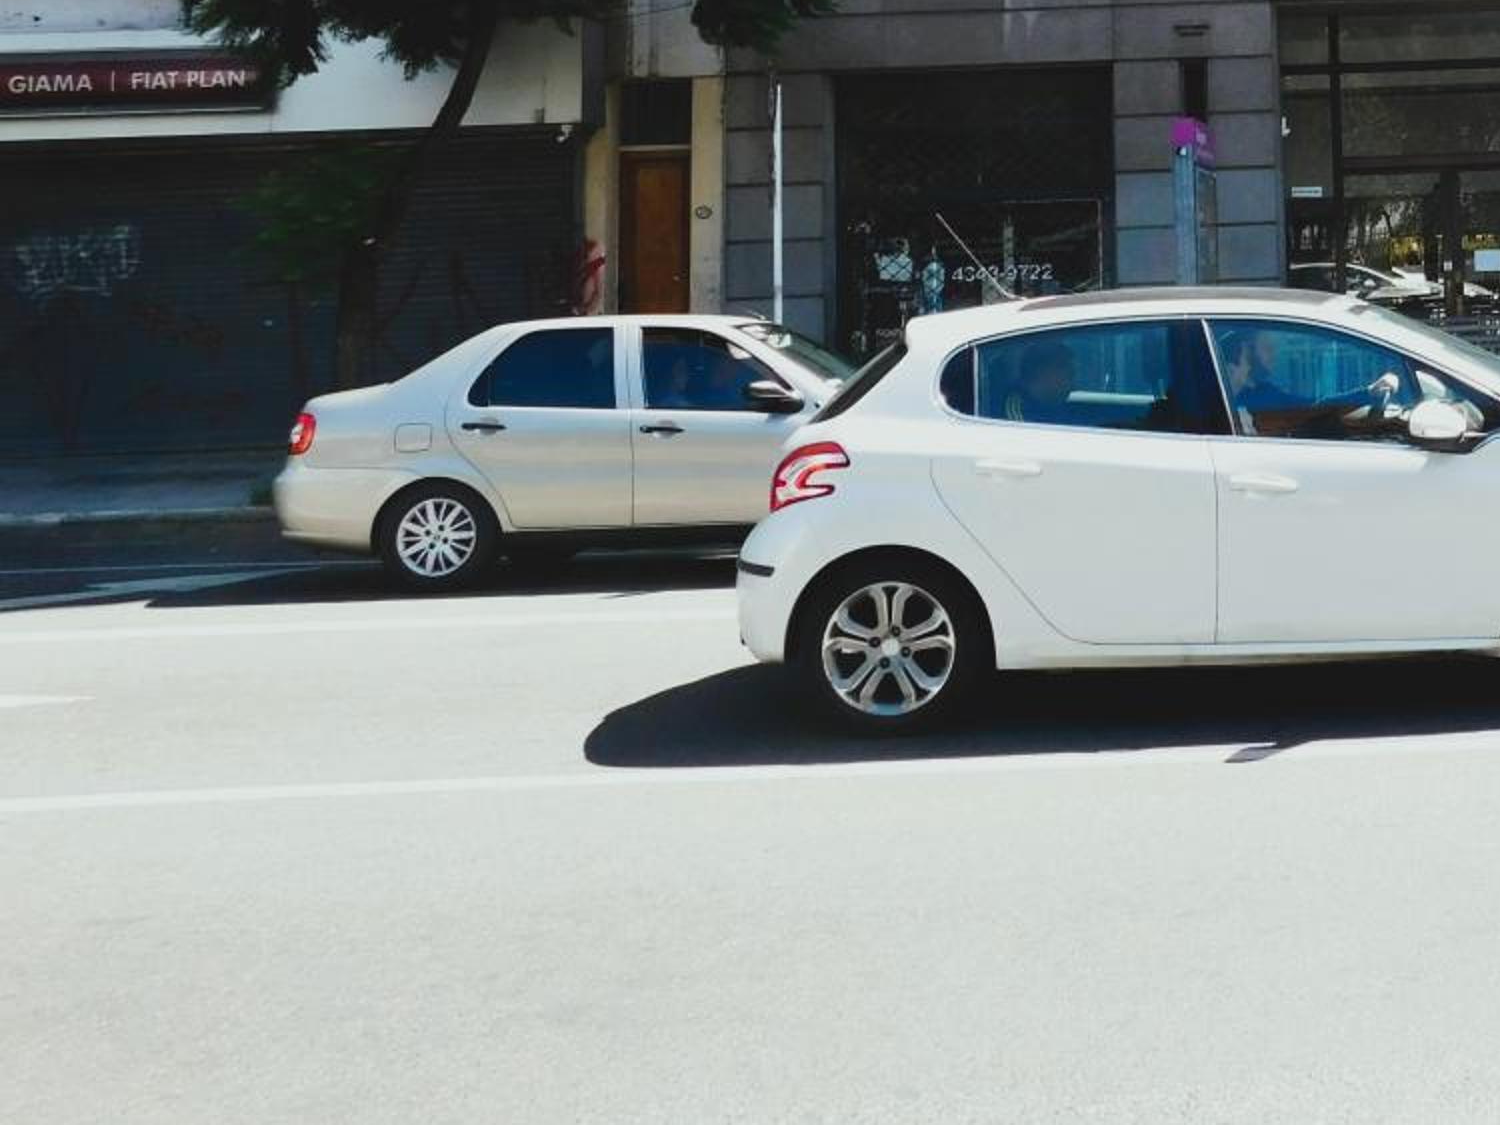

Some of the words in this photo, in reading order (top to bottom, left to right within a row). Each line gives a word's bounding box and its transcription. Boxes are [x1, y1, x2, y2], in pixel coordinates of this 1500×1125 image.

[8, 74, 93, 93] GIAMA
[130, 72, 178, 89] FIAT
[187, 70, 246, 88] PLAN
